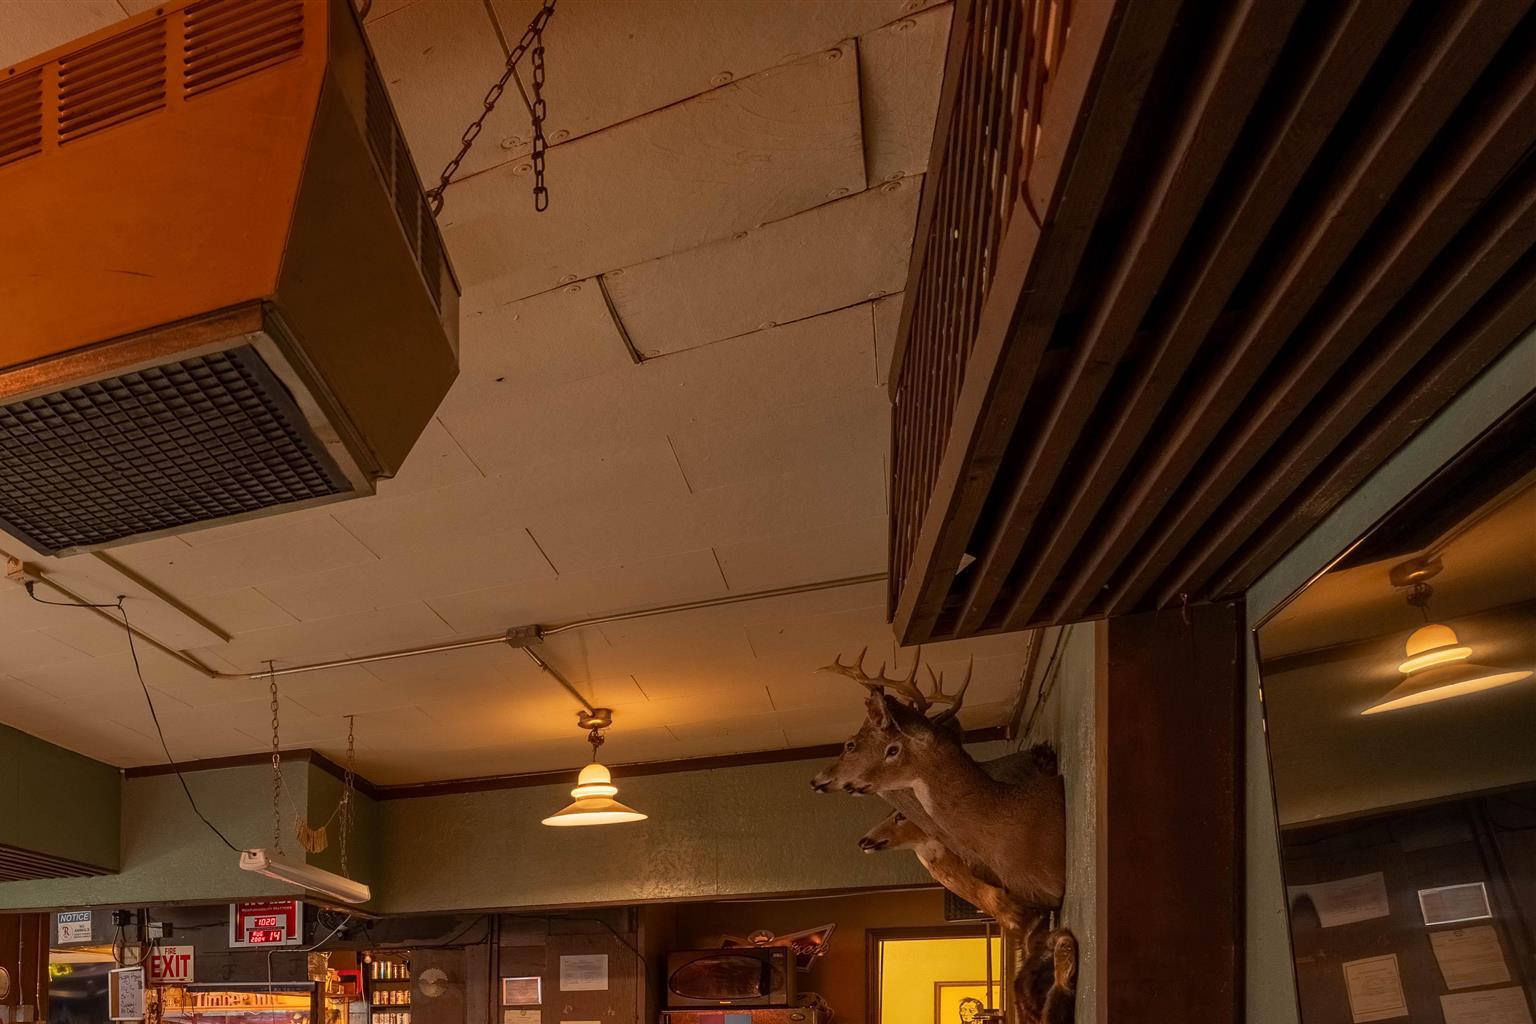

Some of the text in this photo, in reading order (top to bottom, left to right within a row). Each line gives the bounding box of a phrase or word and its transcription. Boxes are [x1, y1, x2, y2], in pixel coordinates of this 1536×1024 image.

[60, 912, 89, 923] NOTICE
[165, 947, 177, 955] FIRE
[151, 955, 191, 978] EXIT
[193, 991, 248, 1007] Timber
